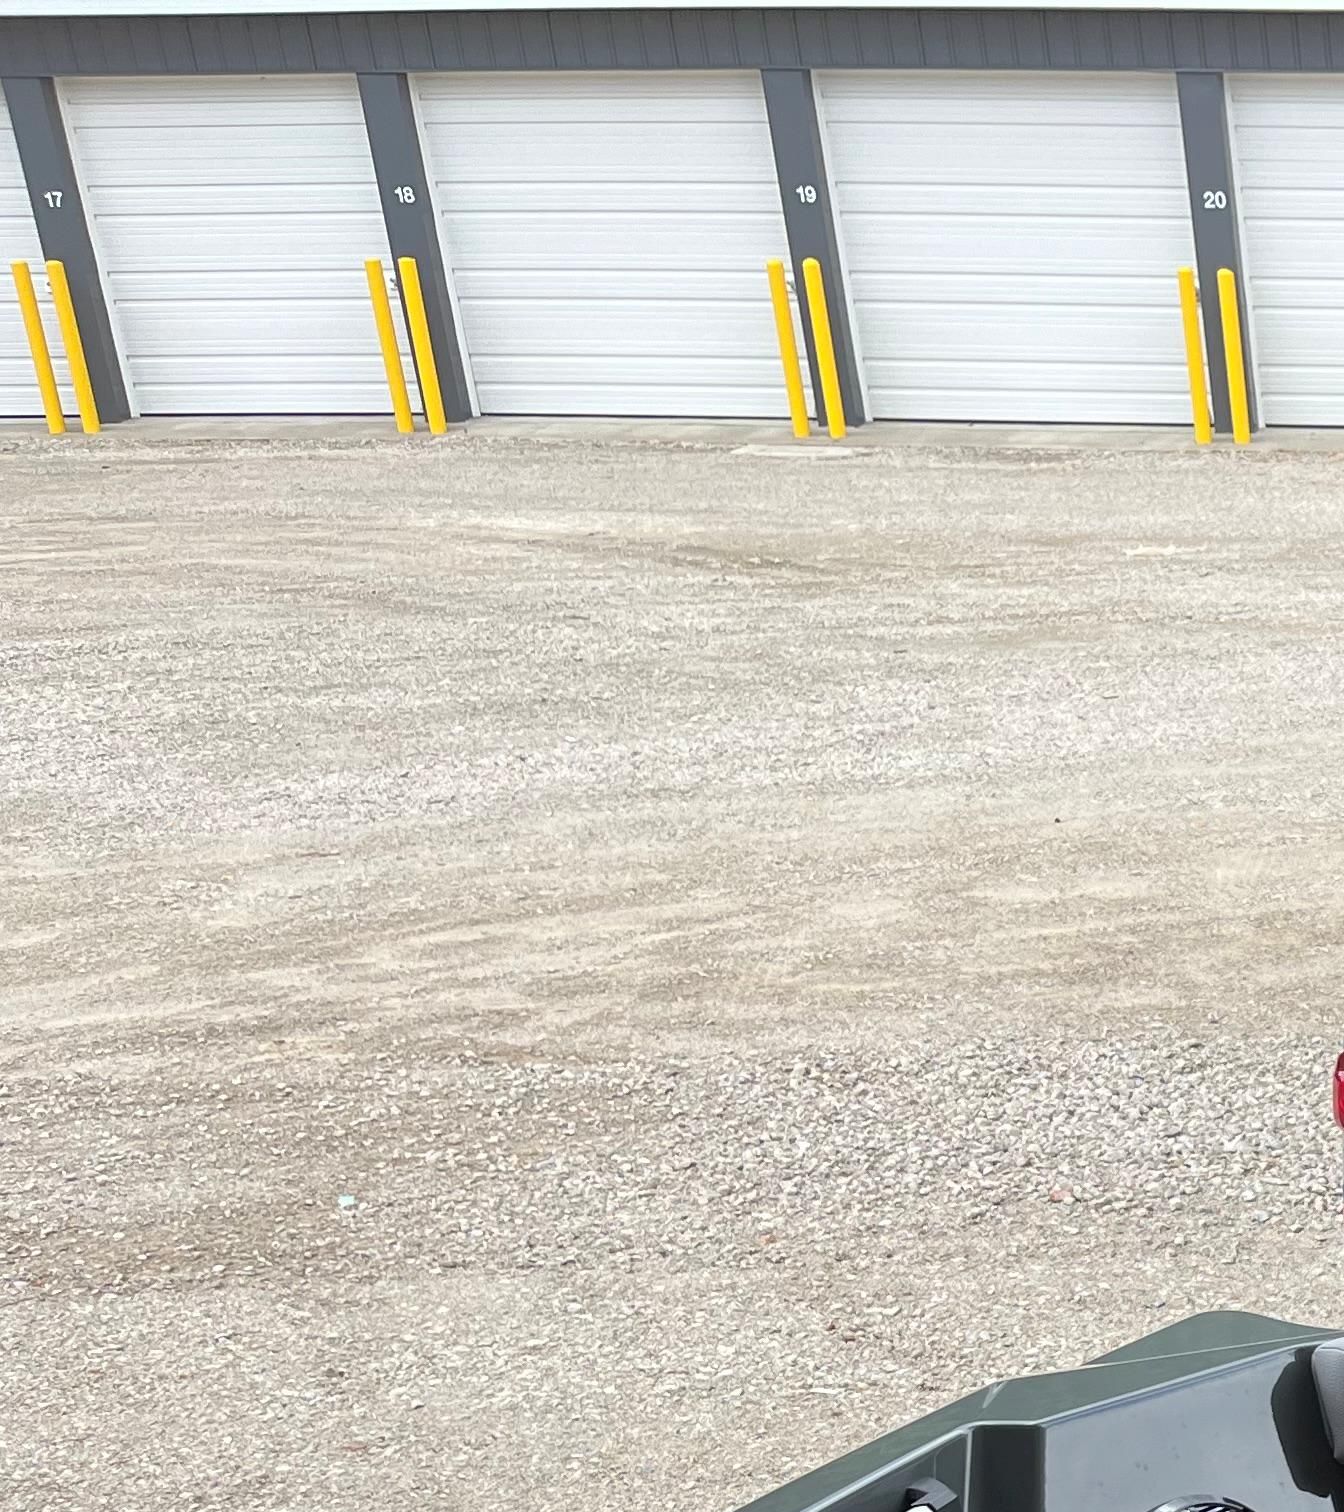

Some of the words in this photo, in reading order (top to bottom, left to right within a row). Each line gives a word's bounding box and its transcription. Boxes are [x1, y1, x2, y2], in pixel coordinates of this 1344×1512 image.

[43, 191, 63, 208] 17
[394, 186, 416, 204] 18
[795, 185, 817, 204] 19
[1202, 190, 1227, 209] 20
